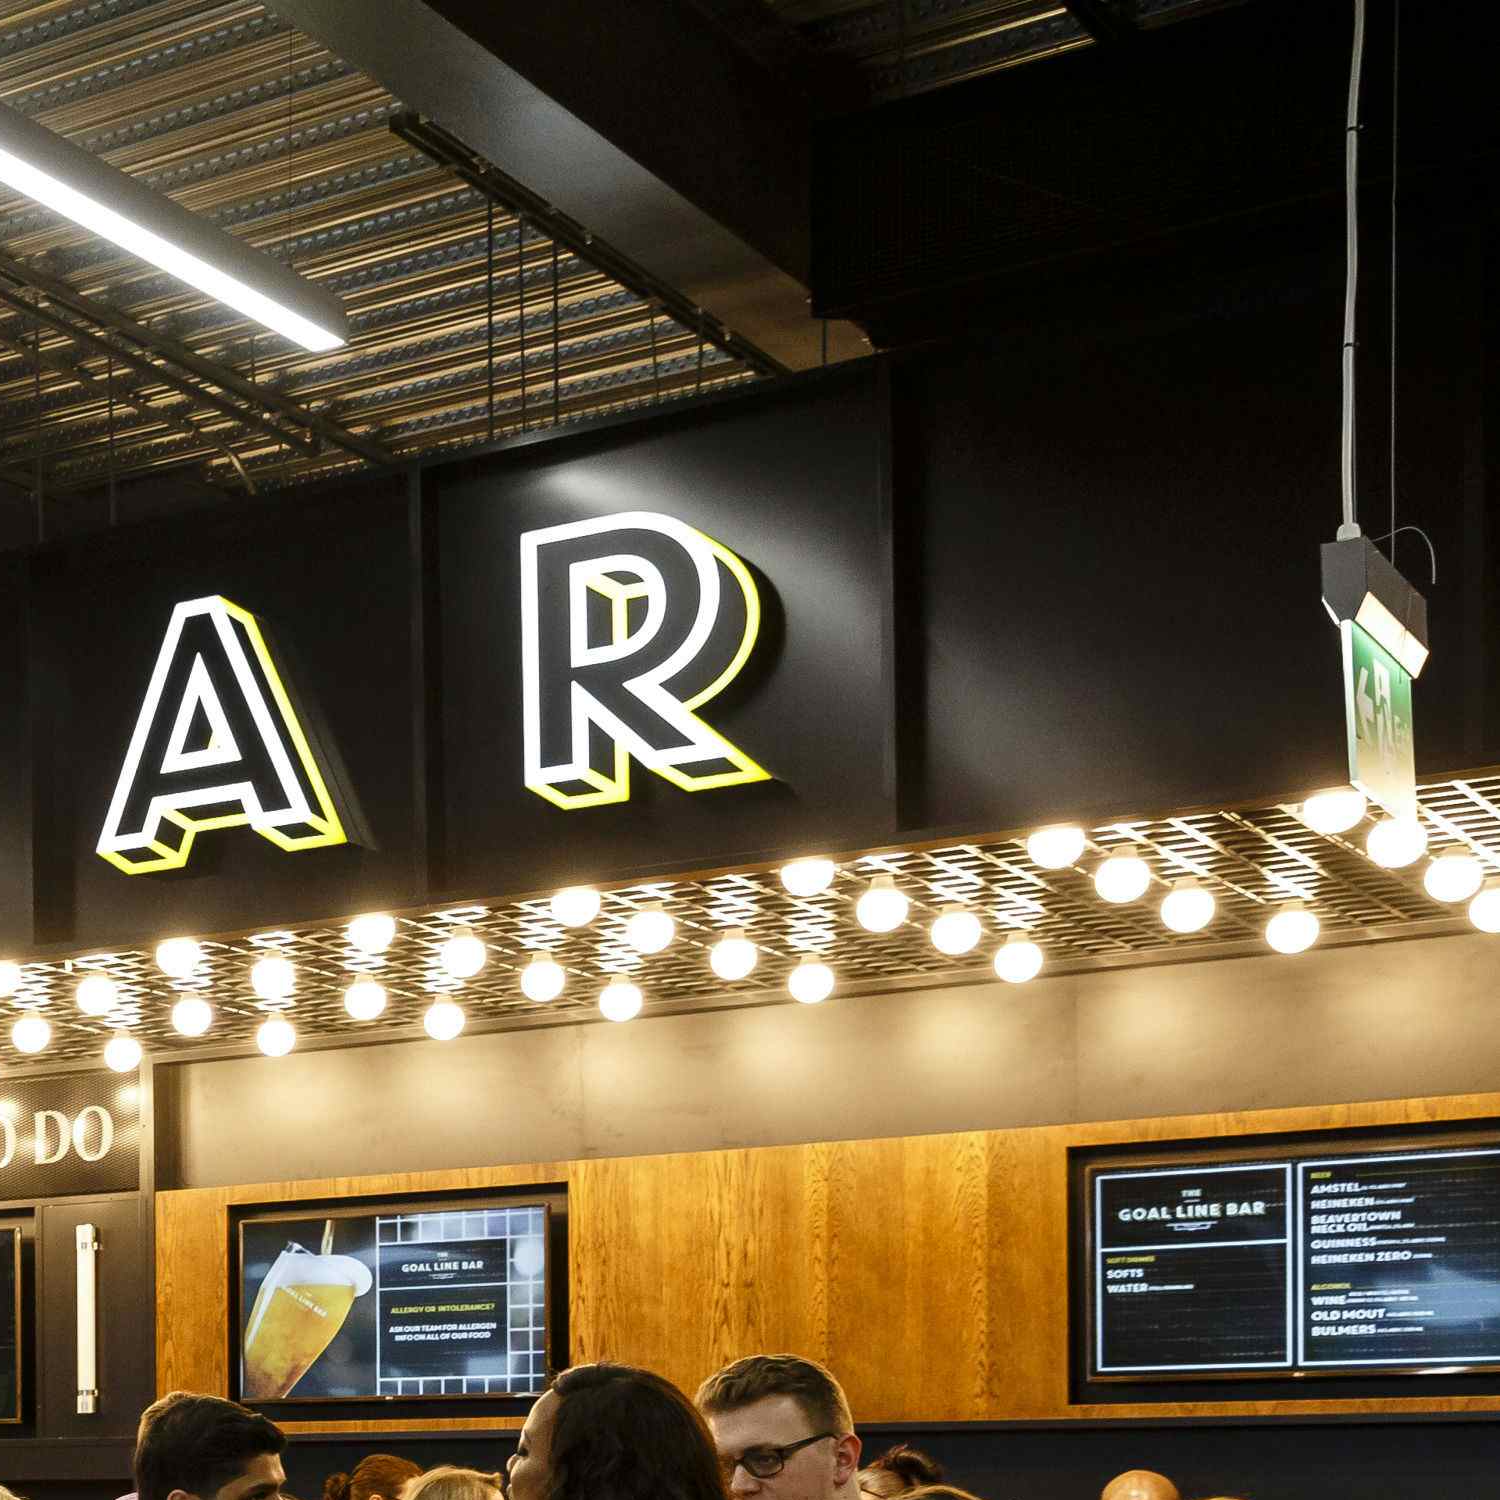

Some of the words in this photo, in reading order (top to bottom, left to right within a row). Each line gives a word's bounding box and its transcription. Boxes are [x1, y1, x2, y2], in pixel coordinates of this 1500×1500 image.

[32, 1105, 115, 1165] DO
[1310, 1182, 1361, 1194] AMSTEL
[1311, 1196, 1375, 1210] HEINEKEN
[1118, 1206, 1172, 1222] GOAL
[1176, 1203, 1221, 1218] LINE
[1225, 1201, 1266, 1216] BAR
[1311, 1210, 1401, 1224] BEAVERTOWN
[1310, 1236, 1377, 1249] GUINNESS
[1311, 1252, 1375, 1265] HEINEKEN
[1376, 1250, 1412, 1262] ZERO
[401, 1263, 432, 1272] GOAL
[434, 1262, 459, 1271] LINE
[461, 1260, 484, 1270] BAR
[1106, 1268, 1144, 1279] SOFTS
[1106, 1283, 1149, 1294] WATER
[1310, 1295, 1347, 1306] WINE
[1310, 1310, 1341, 1321] OLD
[1311, 1324, 1377, 1336] BULMERS
